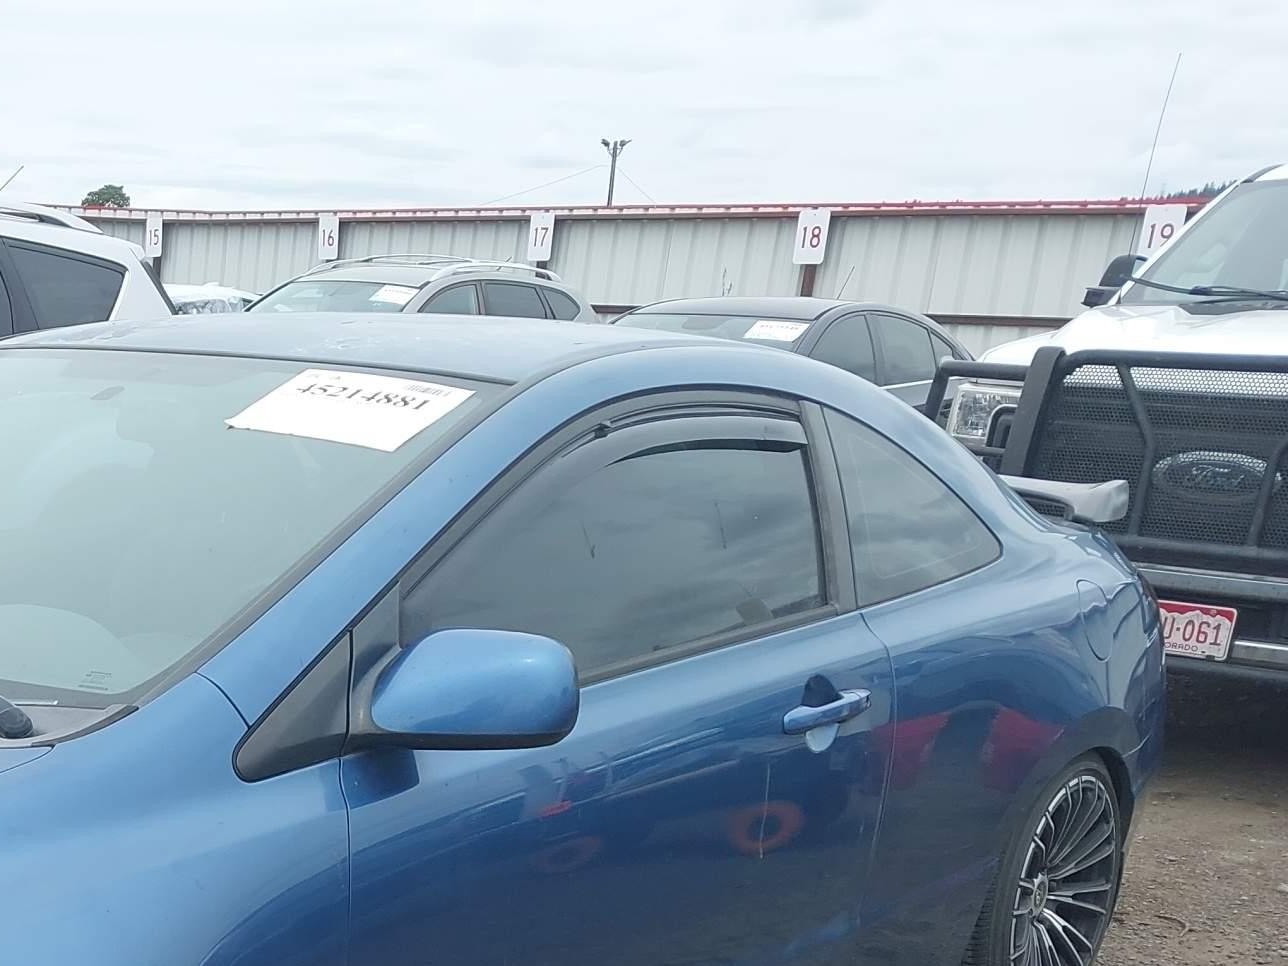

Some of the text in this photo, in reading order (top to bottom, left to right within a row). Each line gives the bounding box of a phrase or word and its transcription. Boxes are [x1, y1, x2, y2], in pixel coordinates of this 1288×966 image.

[149, 229, 159, 246] 15
[322, 229, 335, 246] 16
[533, 227, 550, 247] 17
[801, 226, 822, 249] 18
[1147, 223, 1174, 249] 19
[296, 383, 431, 410] 45214881
